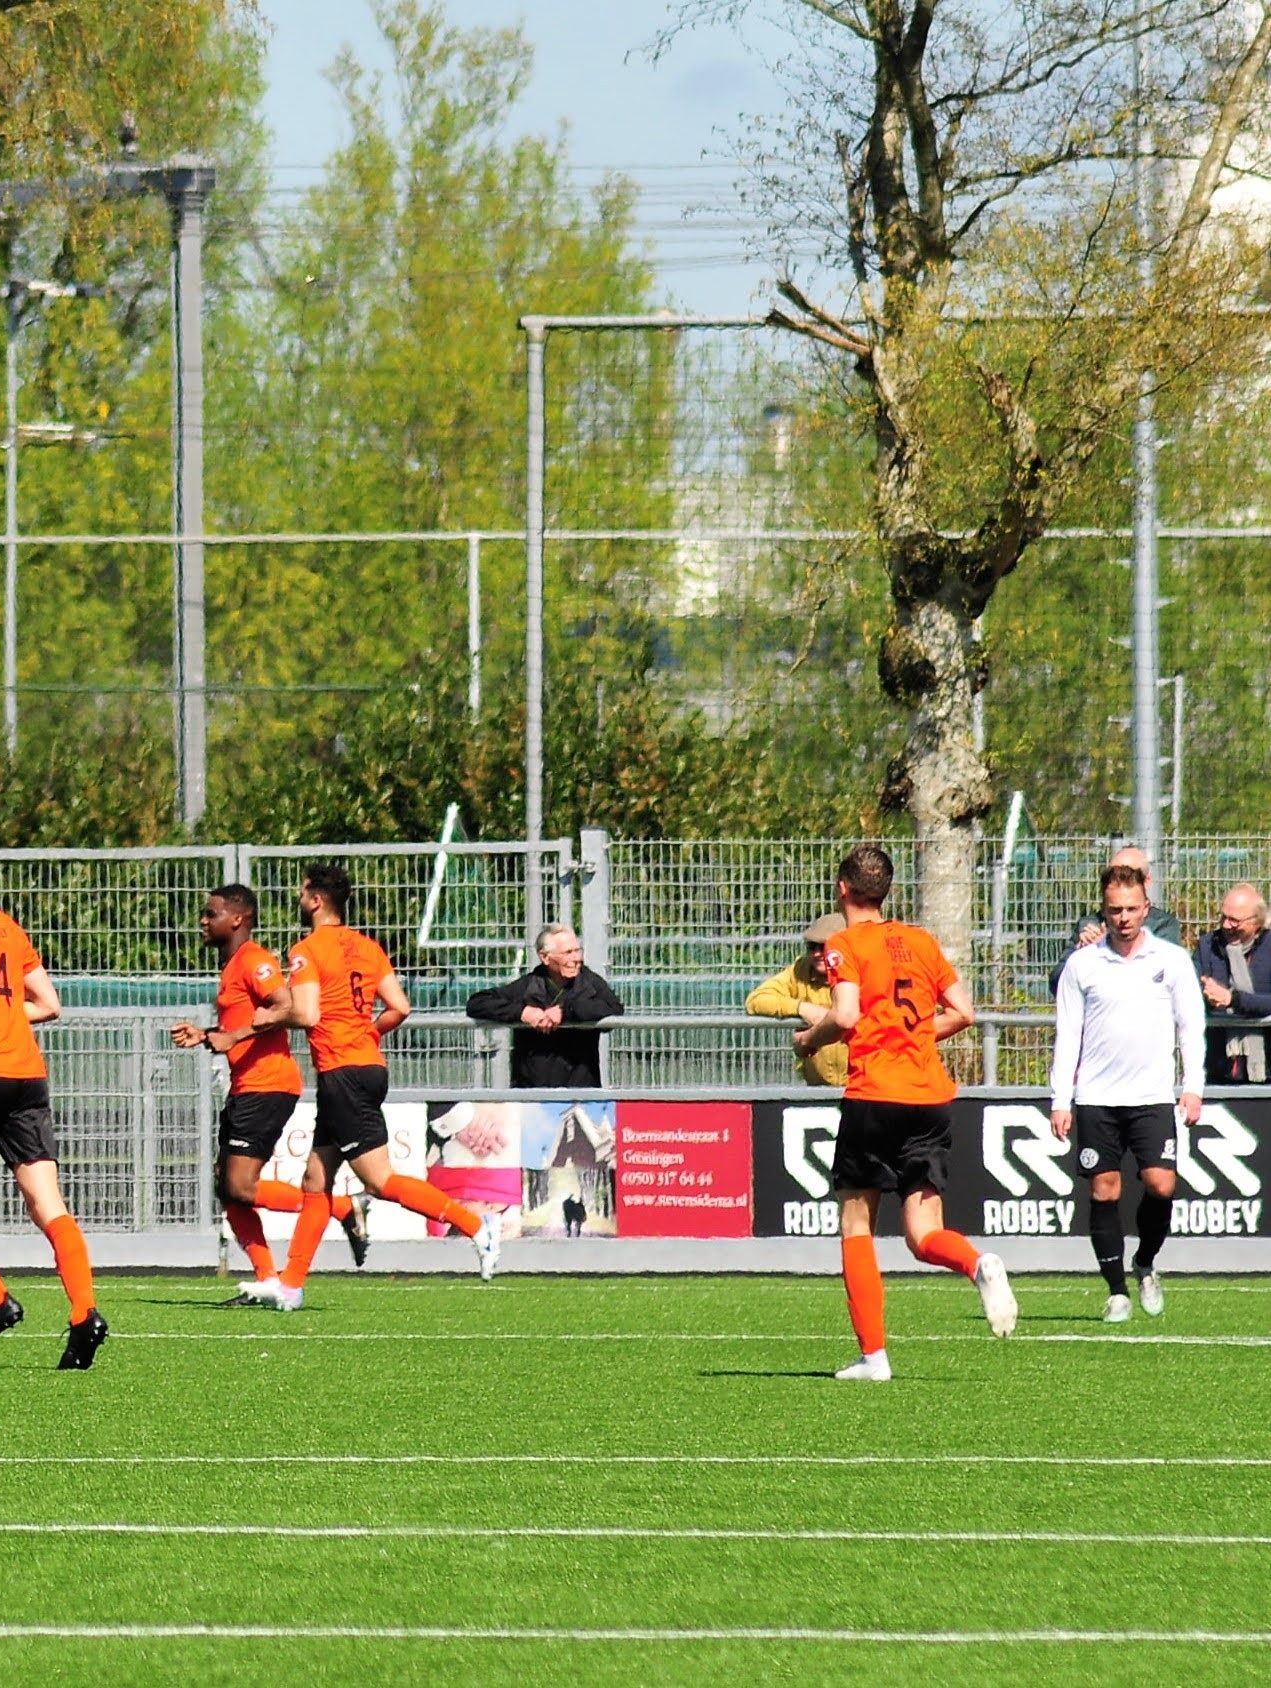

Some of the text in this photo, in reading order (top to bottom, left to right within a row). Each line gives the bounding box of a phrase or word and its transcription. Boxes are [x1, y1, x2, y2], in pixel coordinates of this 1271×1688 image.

[350, 970, 366, 1013] 6
[894, 978, 921, 1032] 5
[622, 1148, 685, 1168] Groningen
[1164, 1138, 1176, 1154] 8
[621, 1170, 713, 1187] (050) 317 64 44
[784, 1201, 840, 1235] ROB
[983, 1200, 1075, 1234] ROBEY
[1171, 1200, 1262, 1234] ROBEY
